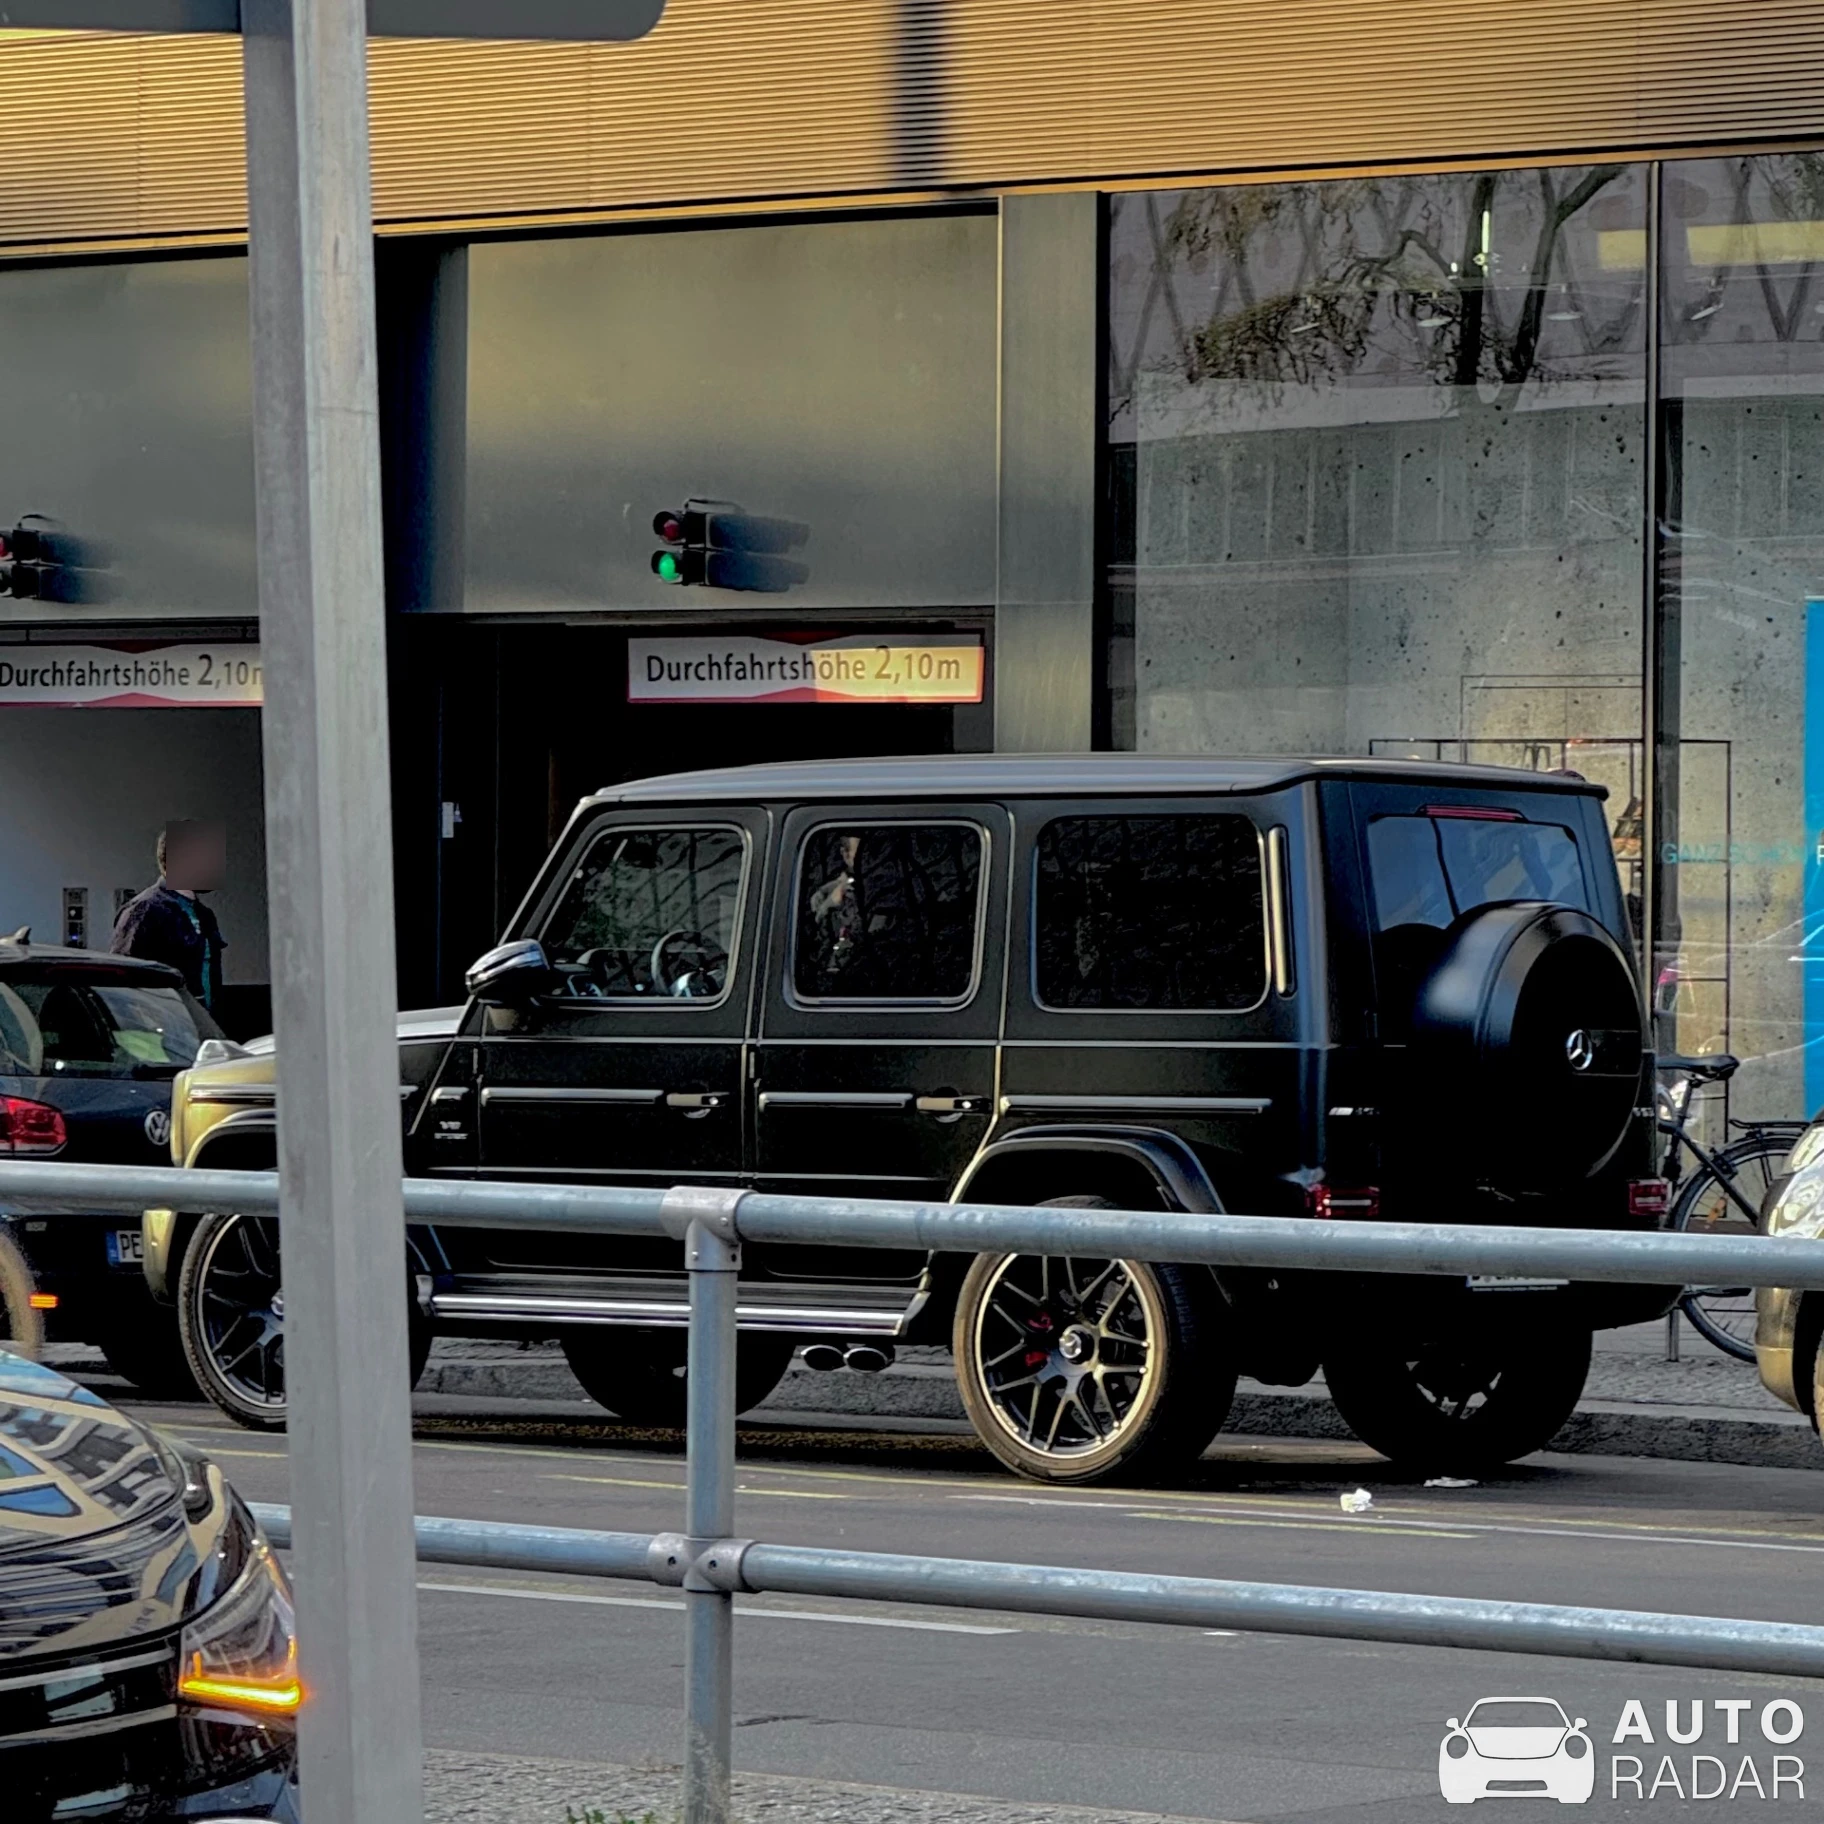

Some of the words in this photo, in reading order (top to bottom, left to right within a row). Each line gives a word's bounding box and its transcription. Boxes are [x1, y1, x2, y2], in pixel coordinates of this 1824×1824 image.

[0, 661, 190, 687] Durchfahrtshöhe
[647, 653, 865, 681] Durchfahrtshöhe
[874, 645, 961, 684] 2,10m
[119, 1233, 143, 1259] PE
